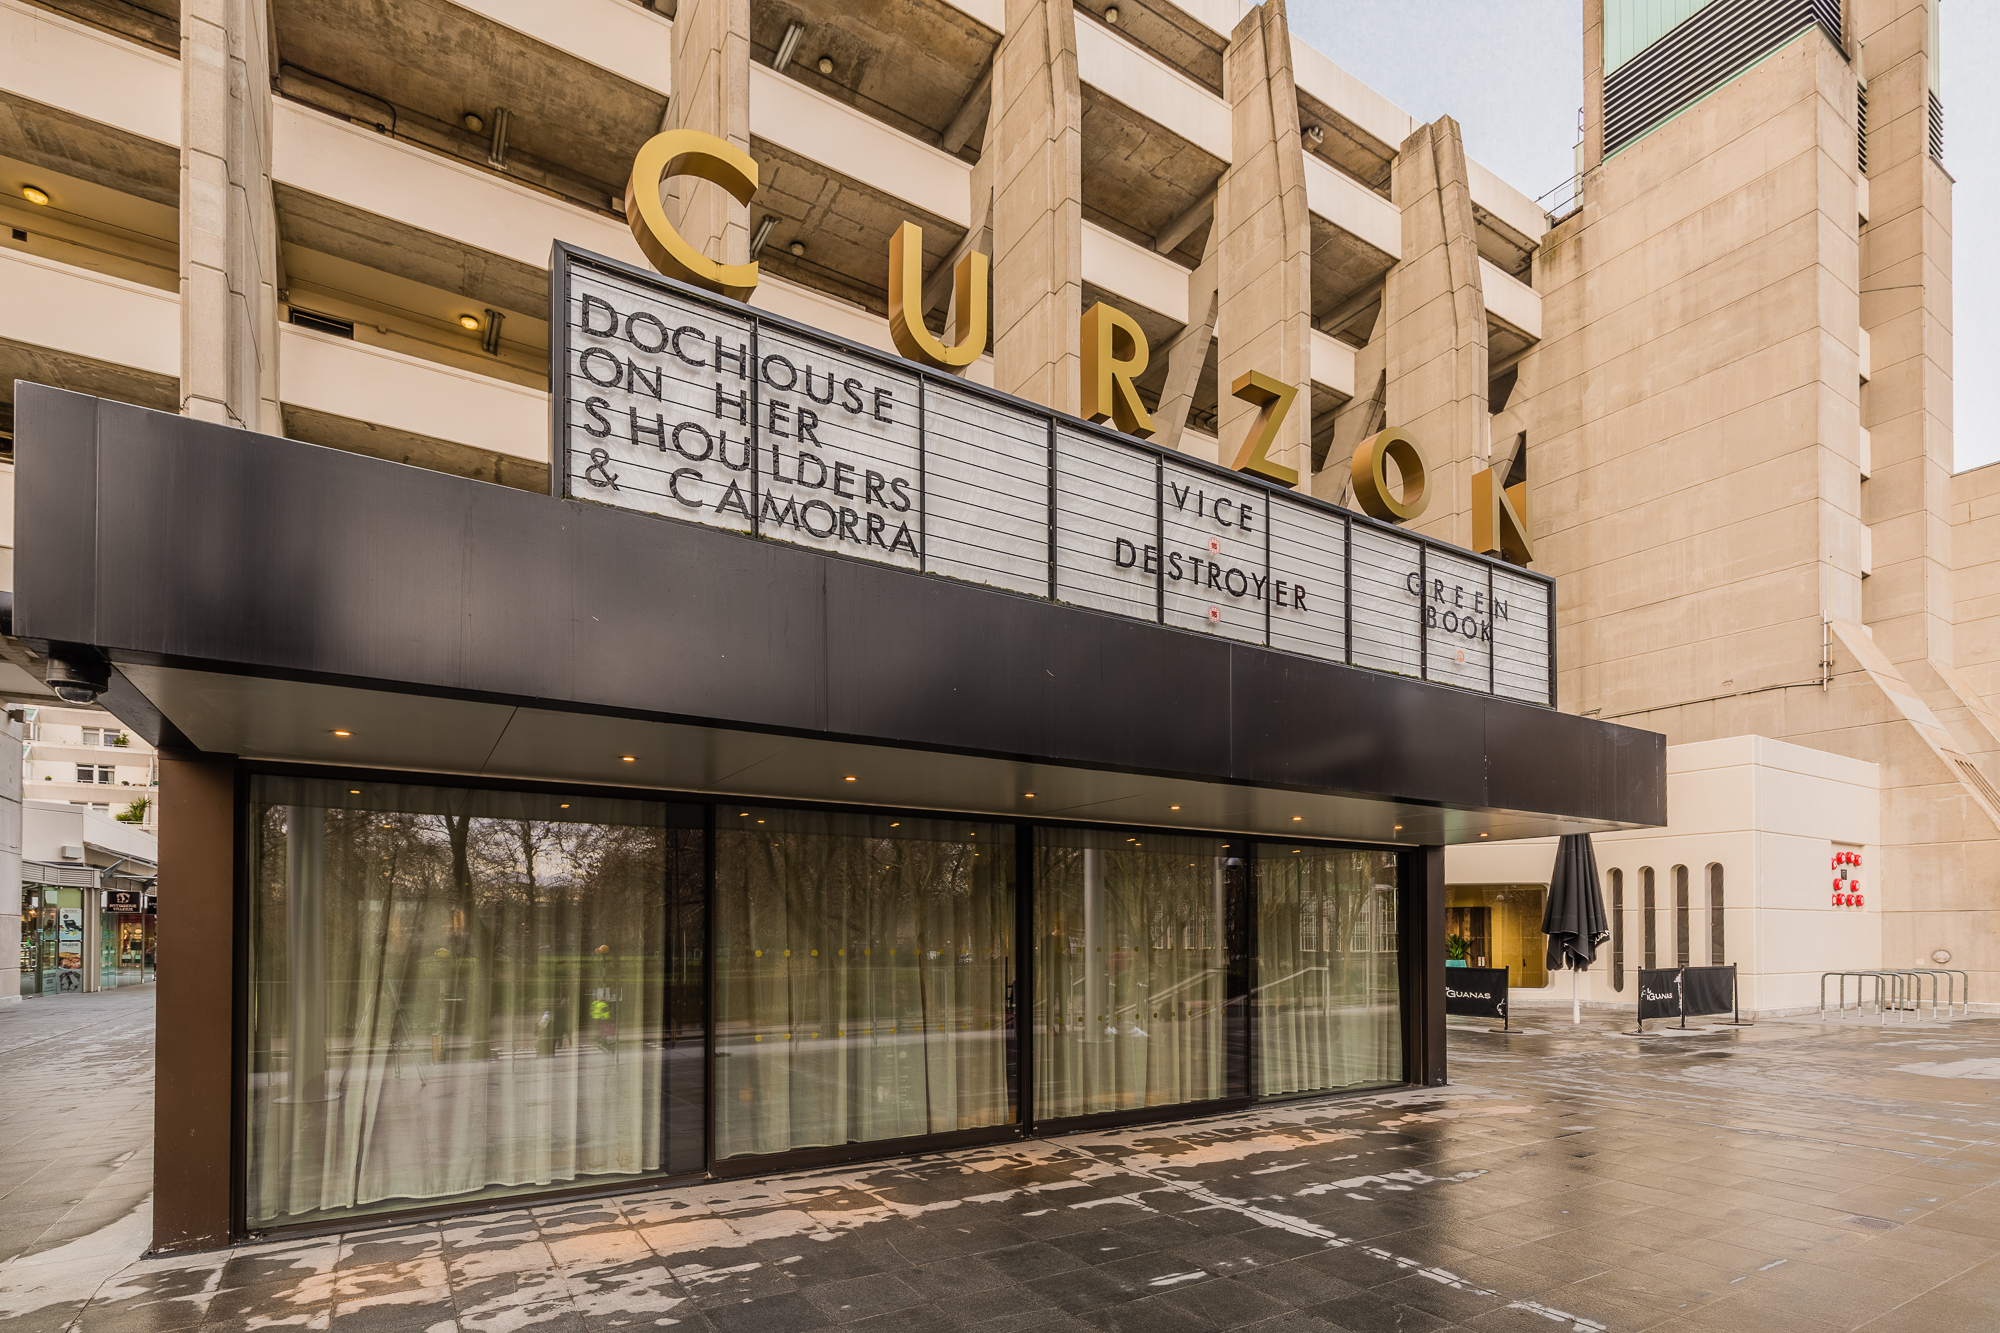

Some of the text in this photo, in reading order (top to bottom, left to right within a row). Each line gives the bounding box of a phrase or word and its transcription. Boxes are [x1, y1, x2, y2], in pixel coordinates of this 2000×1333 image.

[581, 293, 893, 424] DOCHOUSE
[625, 128, 1533, 562] CURZON
[579, 347, 822, 448] ON HER
[583, 396, 911, 512] SHOULDERS
[585, 447, 919, 558] & CAMORRA
[1170, 482, 1252, 532] VICE
[1115, 537, 1308, 612] DESTROYER
[1406, 571, 1508, 621] GREEN
[1427, 604, 1492, 644] BOOK
[1446, 989, 1491, 1000] GUANAS
